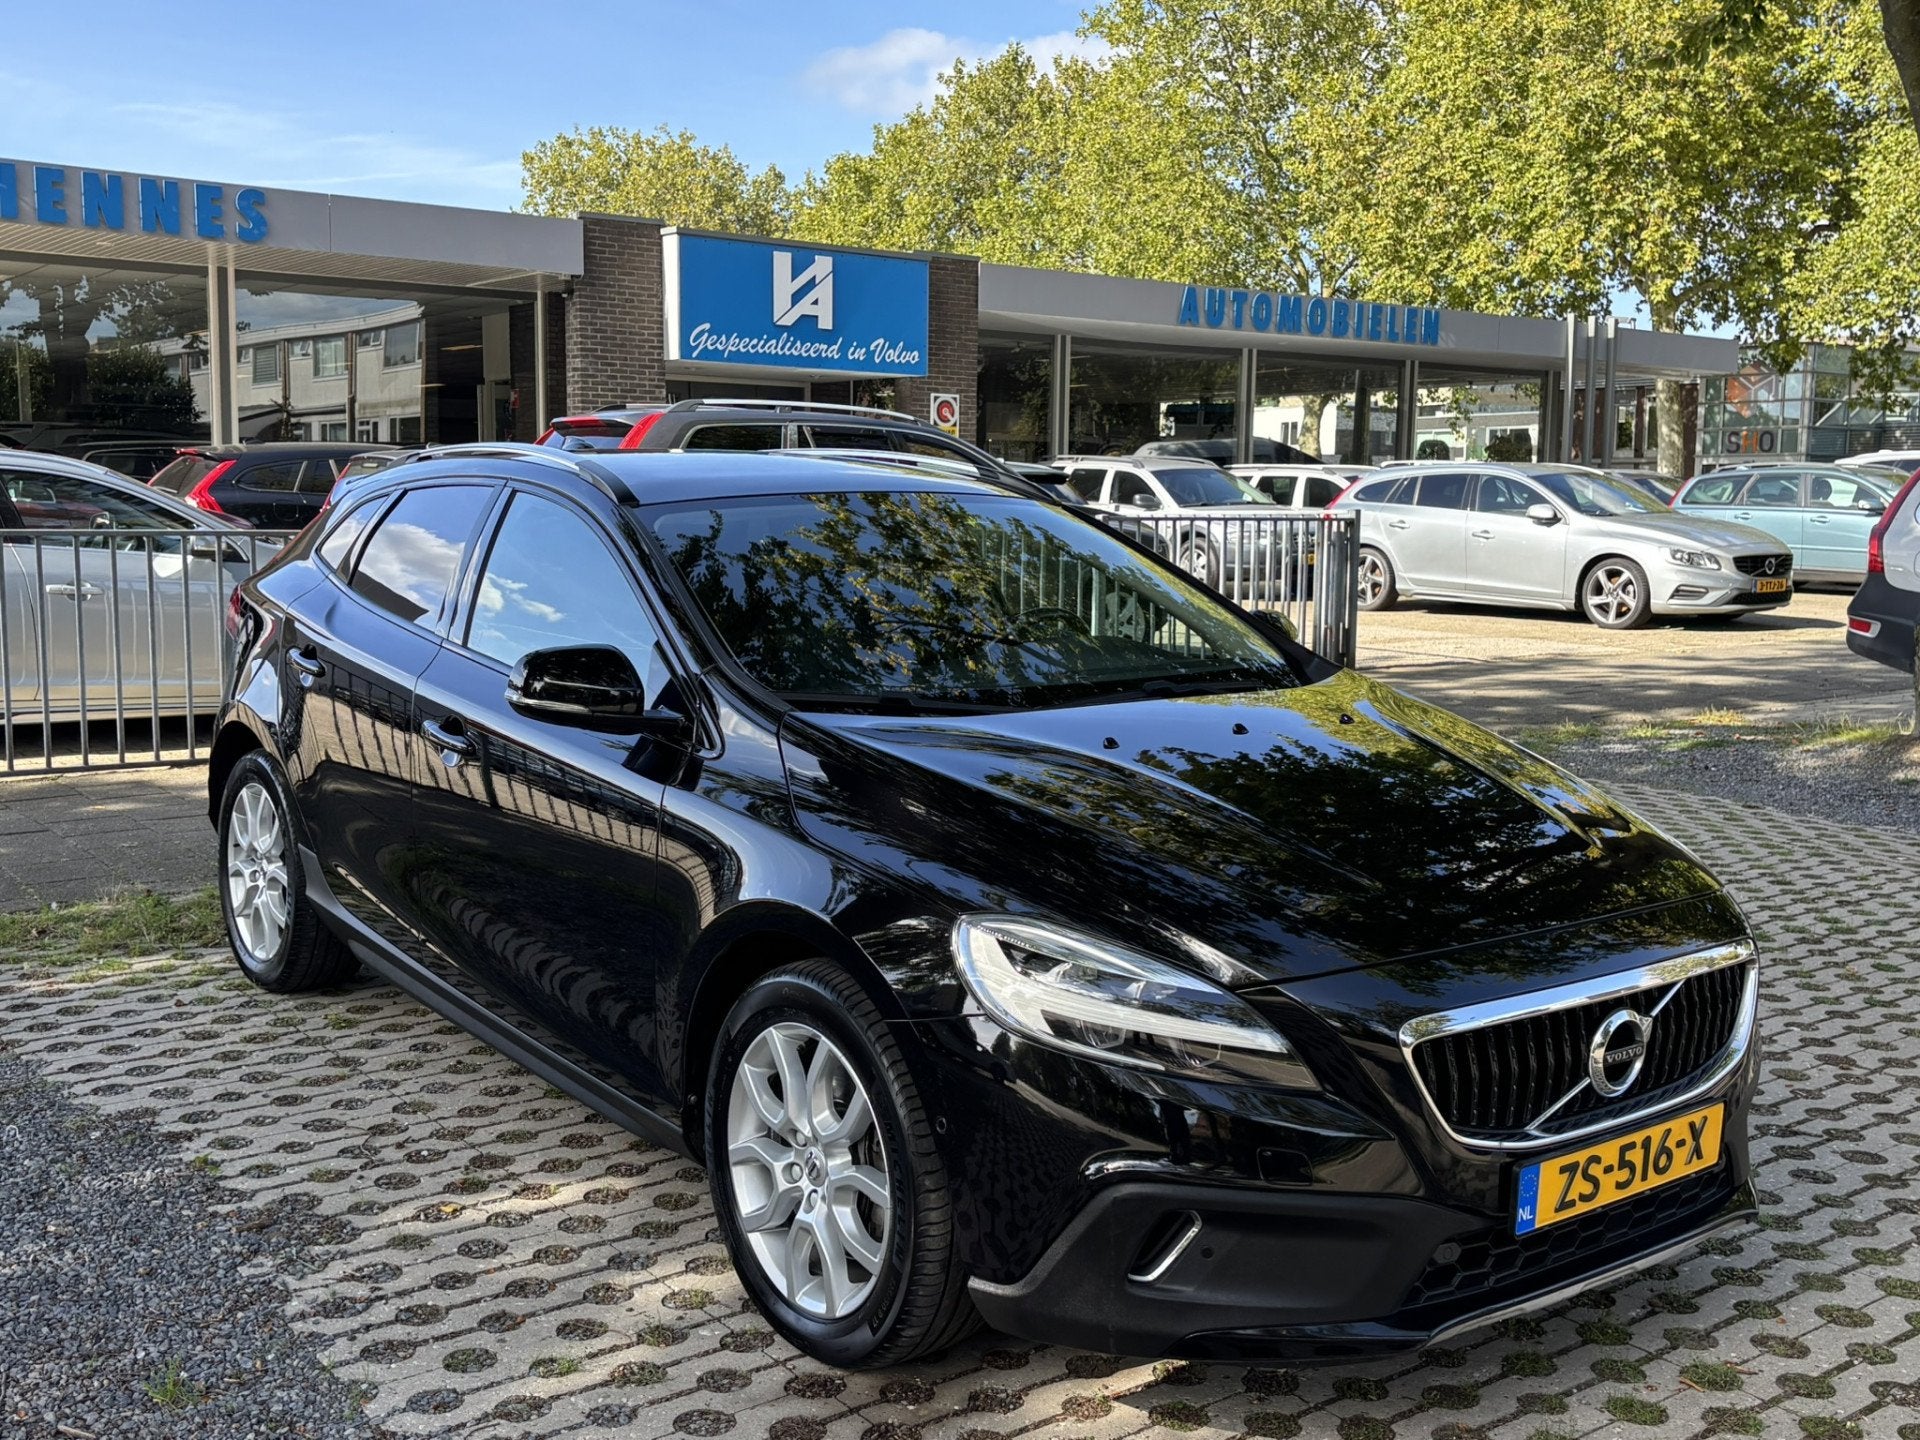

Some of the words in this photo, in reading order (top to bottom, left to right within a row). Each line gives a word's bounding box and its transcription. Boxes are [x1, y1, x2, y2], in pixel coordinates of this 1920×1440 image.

[1179, 285, 1440, 346] AUTOMOBIELEN
[690, 322, 843, 358] Gespecialiseerd
[848, 341, 866, 361] in
[870, 338, 920, 365] Volvo
[1725, 430, 1775, 454] SHO
[1606, 1046, 1643, 1063] VOLVO
[1554, 1115, 1708, 1213] ZS-516-X
[882, 1120, 908, 1262] MICHELIN
[1518, 1205, 1534, 1222] NL
